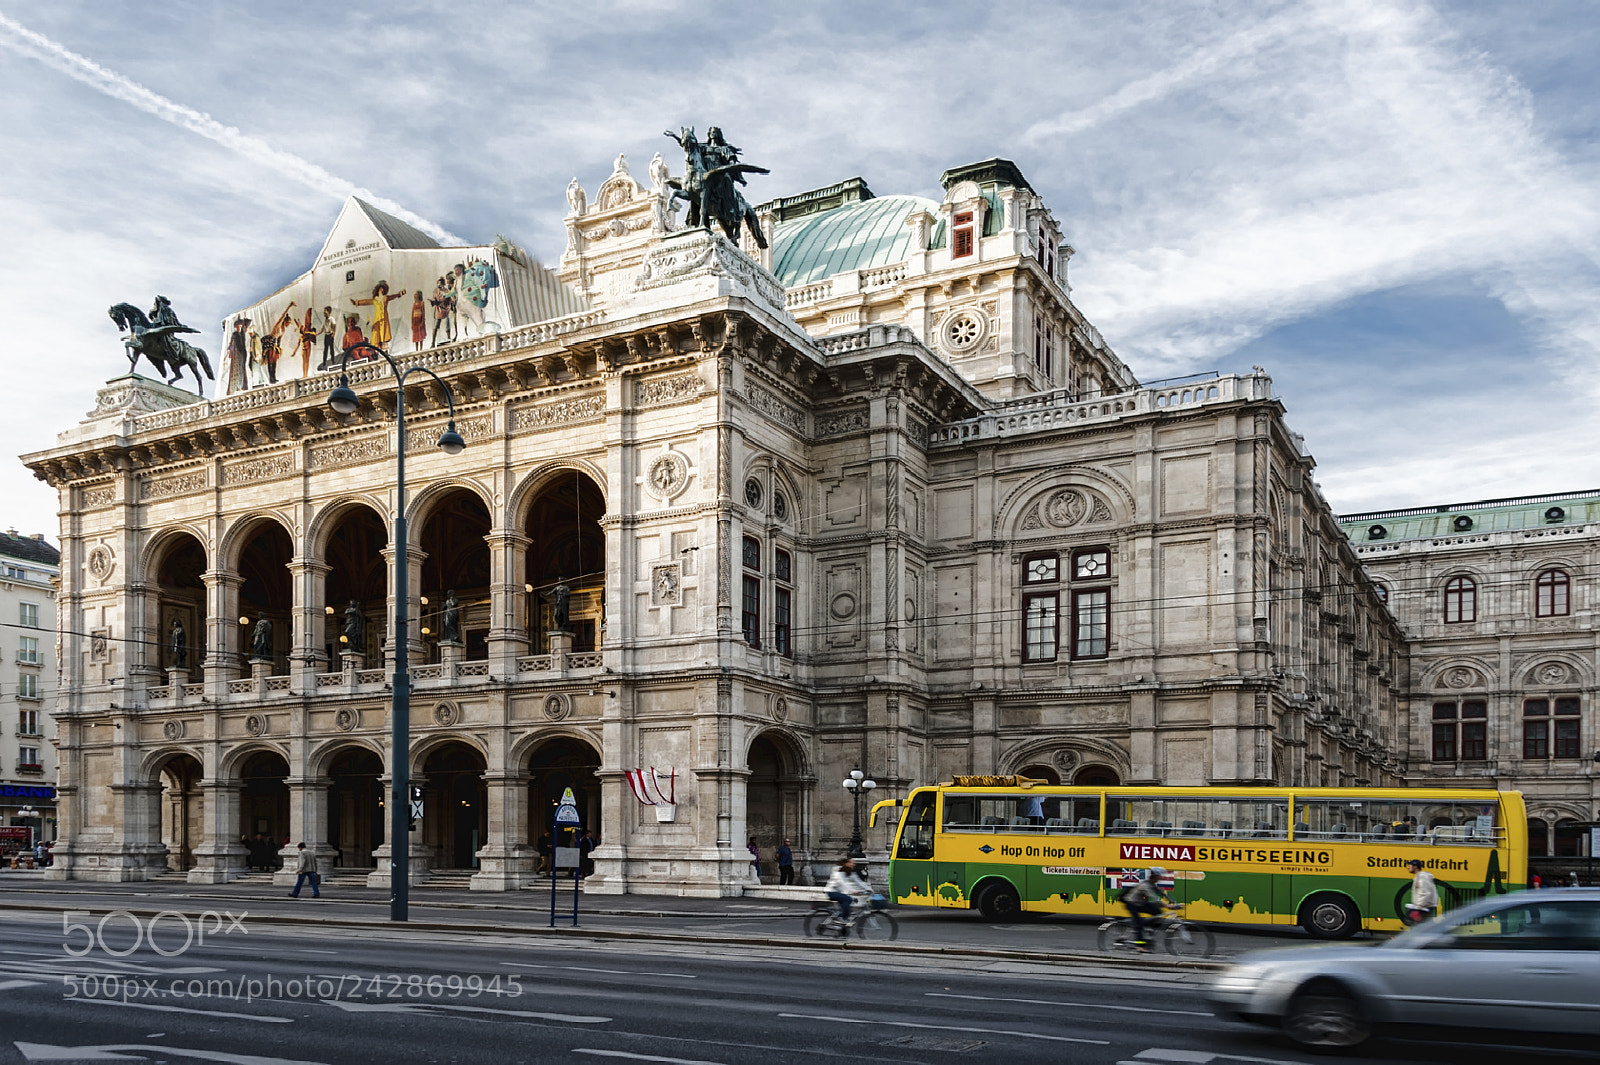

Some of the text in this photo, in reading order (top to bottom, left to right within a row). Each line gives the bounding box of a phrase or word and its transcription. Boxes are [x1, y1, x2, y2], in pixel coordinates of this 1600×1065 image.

[345, 242, 380, 254] STAATSOPER
[1001, 845, 1022, 857] Hop
[1026, 846, 1039, 856] On
[1043, 846, 1065, 858] Hop
[1069, 847, 1085, 857] Off
[1122, 845, 1330, 863] VIENNA SIGHTSEEING
[1367, 856, 1468, 870] Stadtrdfahrt
